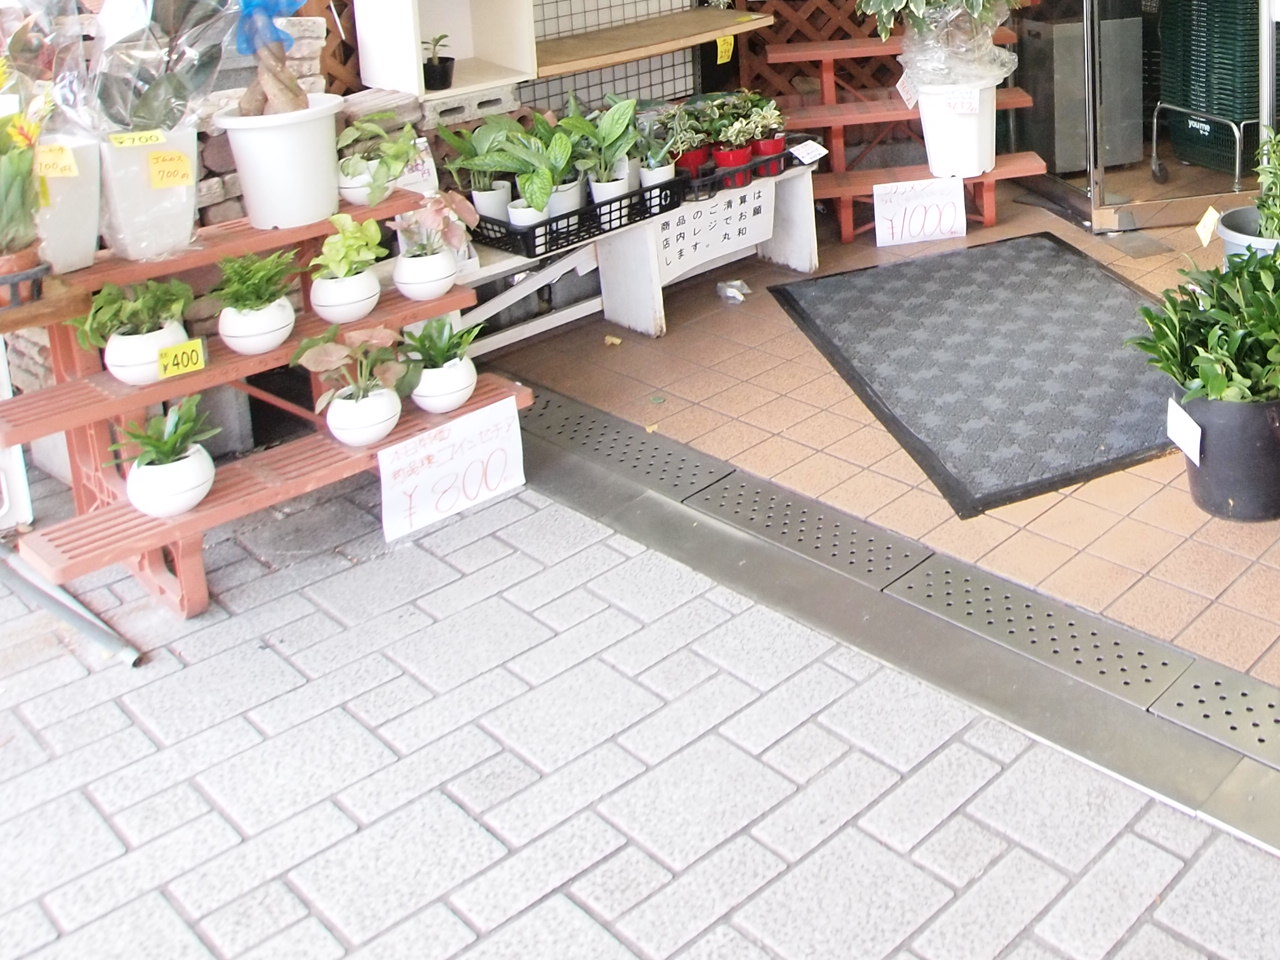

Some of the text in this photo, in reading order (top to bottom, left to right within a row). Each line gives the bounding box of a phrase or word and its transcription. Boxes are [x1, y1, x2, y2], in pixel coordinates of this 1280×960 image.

[660, 190, 764, 233] 商品のご清算は
[662, 205, 763, 250] 店内レジでお願
[721, 227, 748, 242] 丸和
[162, 349, 199, 375] ¥400
